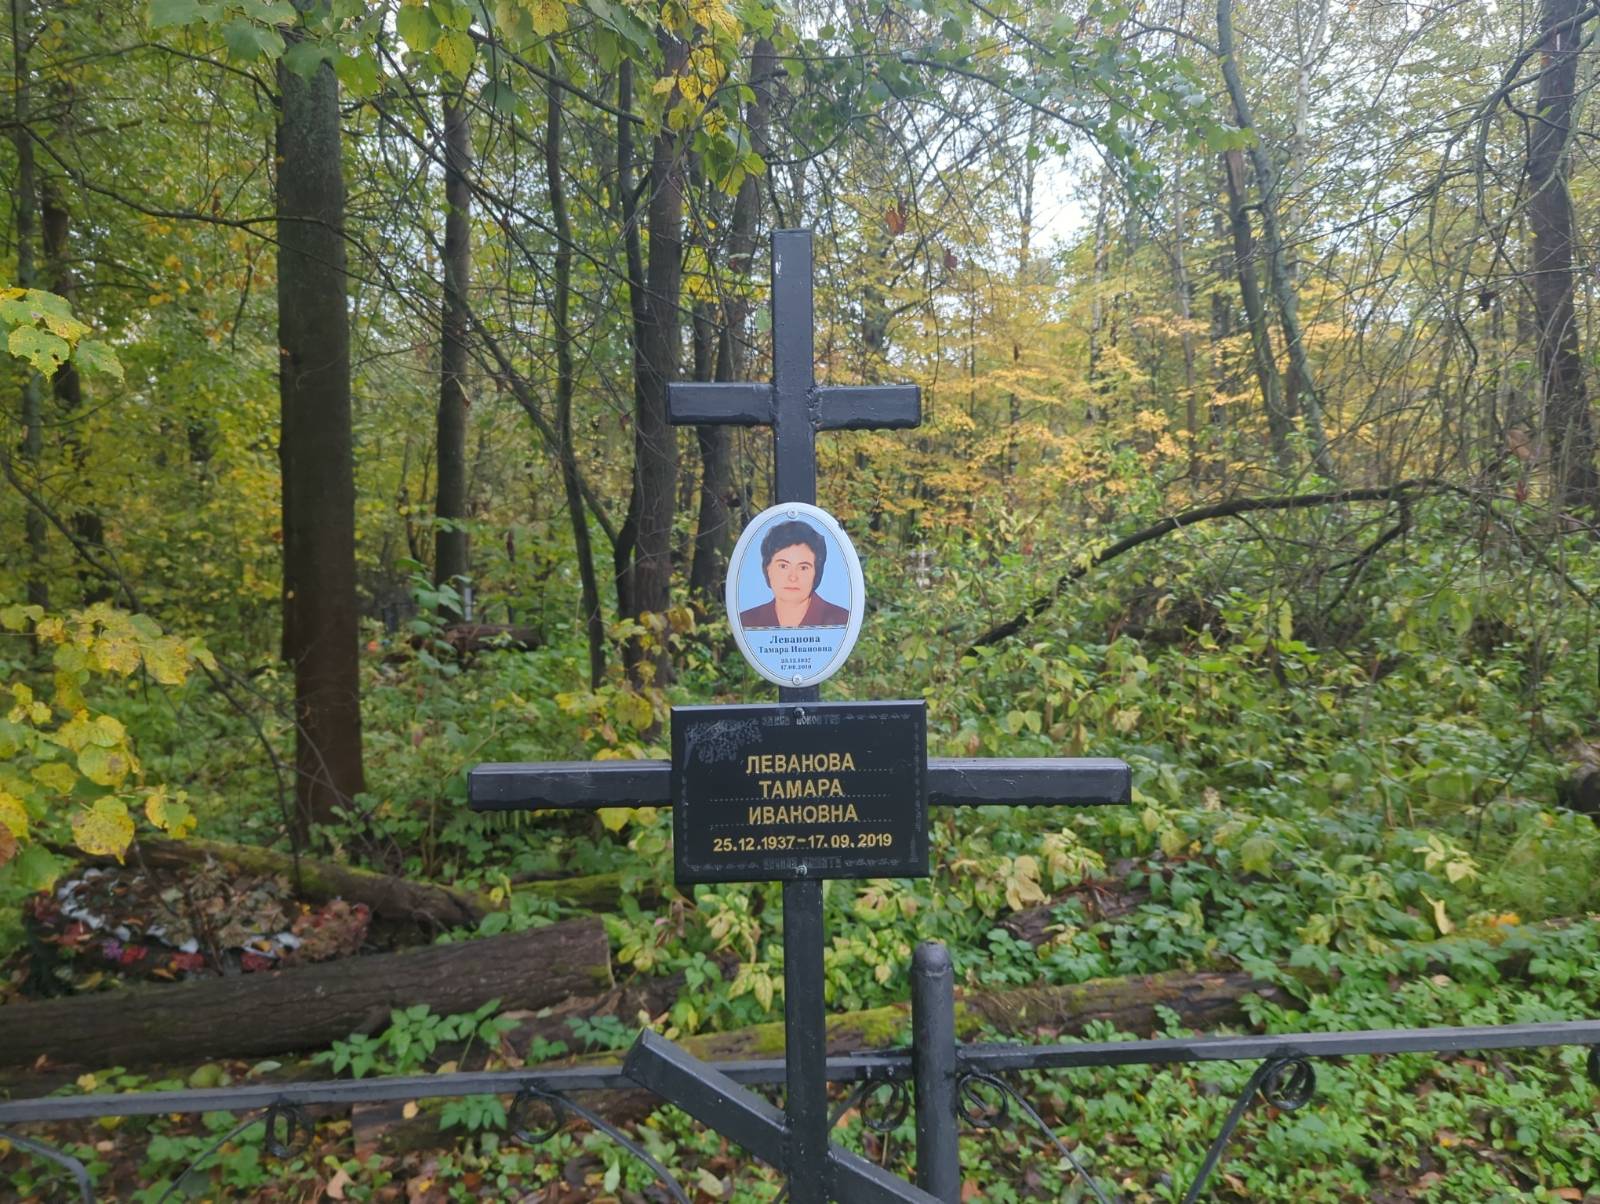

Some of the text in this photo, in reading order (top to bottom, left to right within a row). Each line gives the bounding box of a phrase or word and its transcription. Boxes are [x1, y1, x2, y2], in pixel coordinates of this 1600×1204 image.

[759, 645, 832, 655] Тамара Ивановна
[770, 635, 821, 644] Леванова
[745, 753, 856, 774] ЛЕВАНОВА
[759, 778, 845, 799] ТАМАРА
[749, 803, 859, 825] ИВАНОВНА
